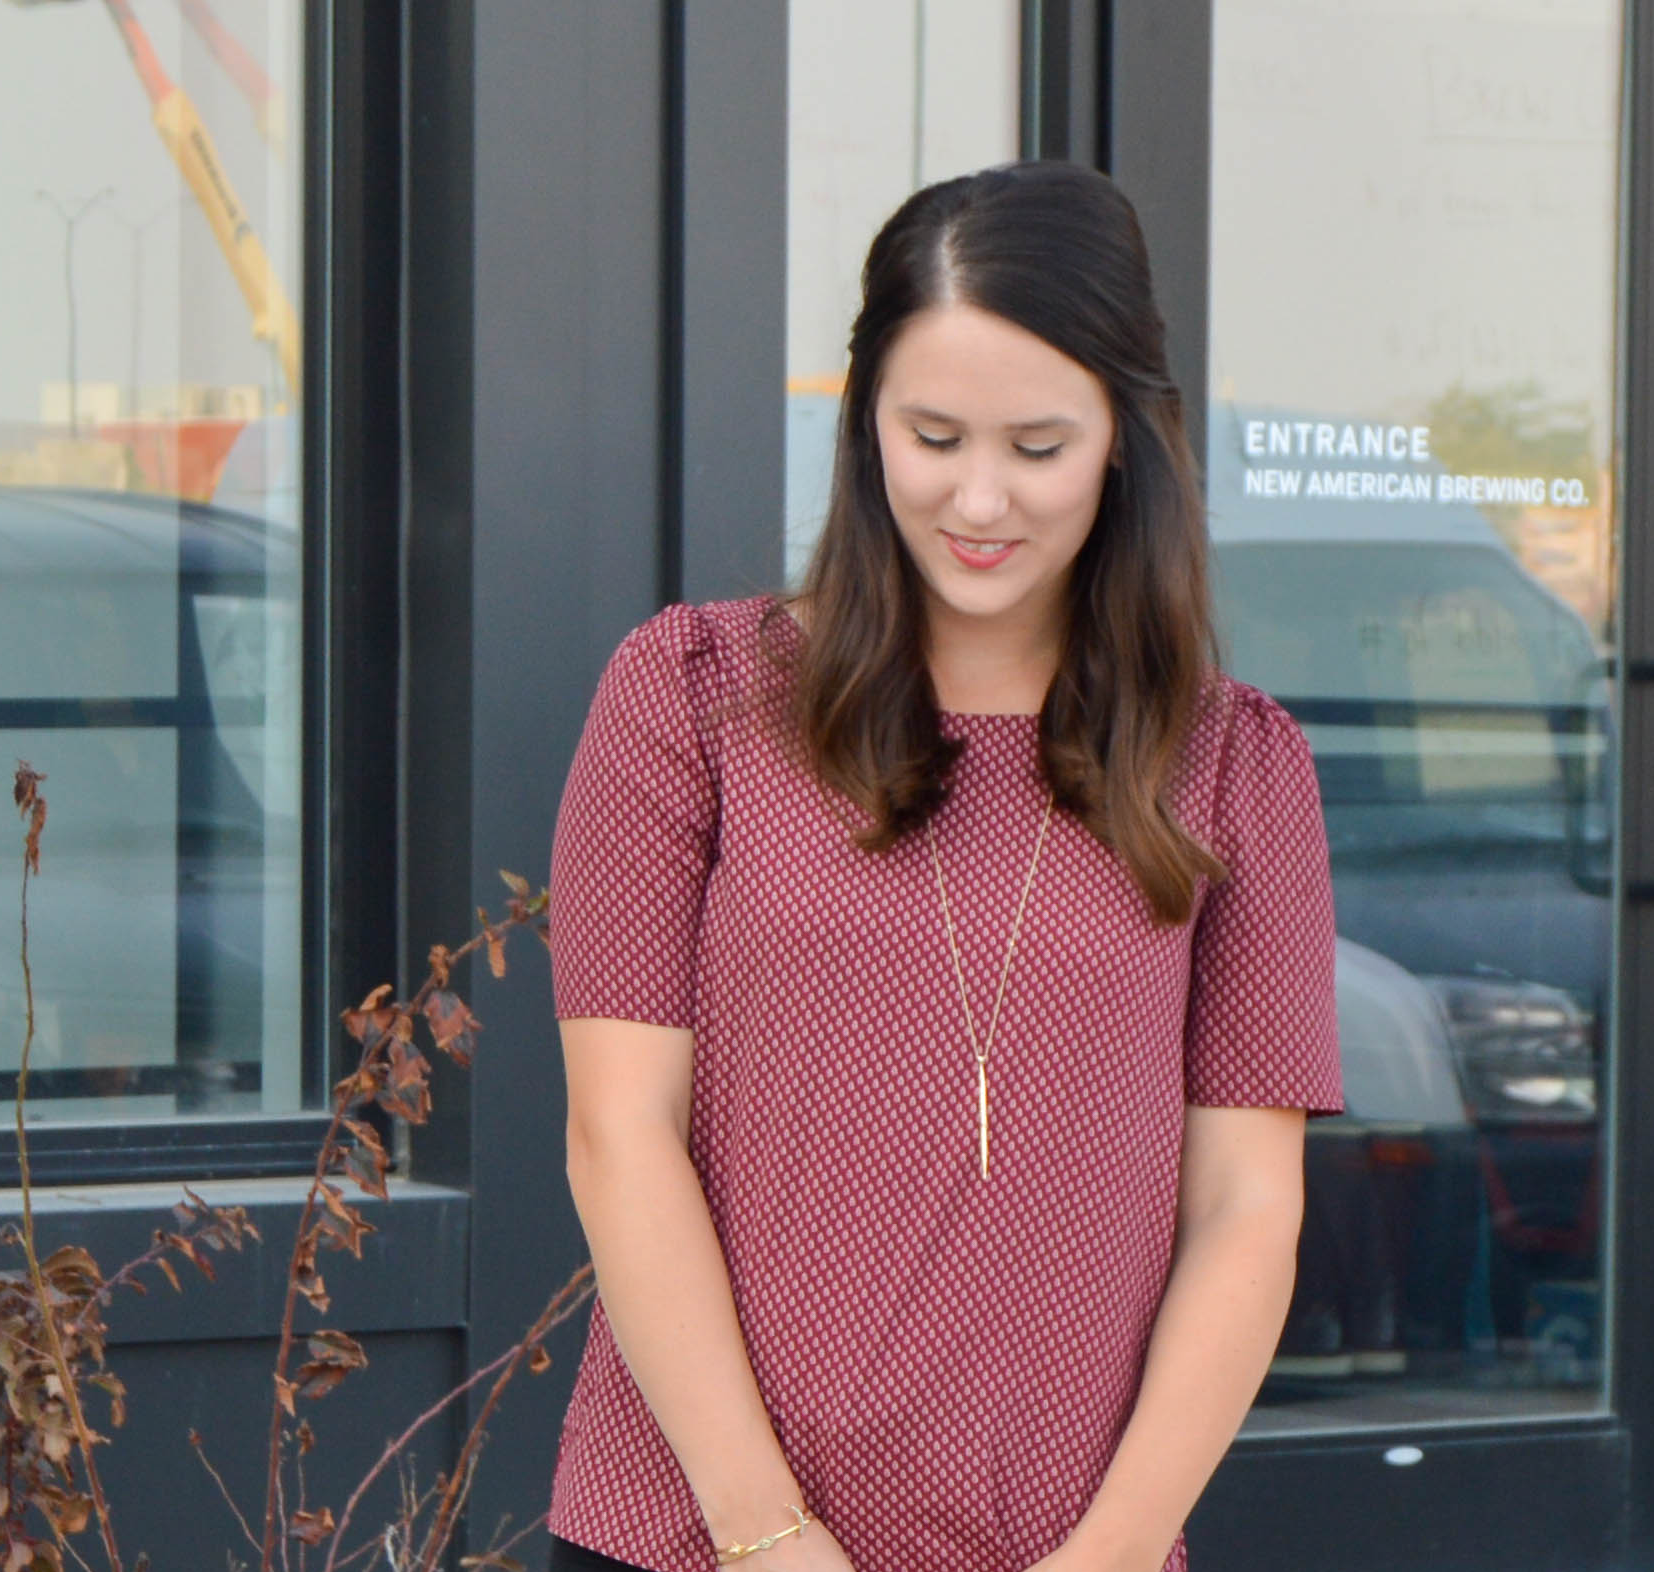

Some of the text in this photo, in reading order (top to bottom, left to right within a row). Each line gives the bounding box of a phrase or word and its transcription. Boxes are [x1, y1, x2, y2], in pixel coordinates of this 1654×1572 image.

[1246, 421, 1430, 460] ENTRANCE
[1246, 468, 1589, 508] NEW AMERICAN BREWING CO.
